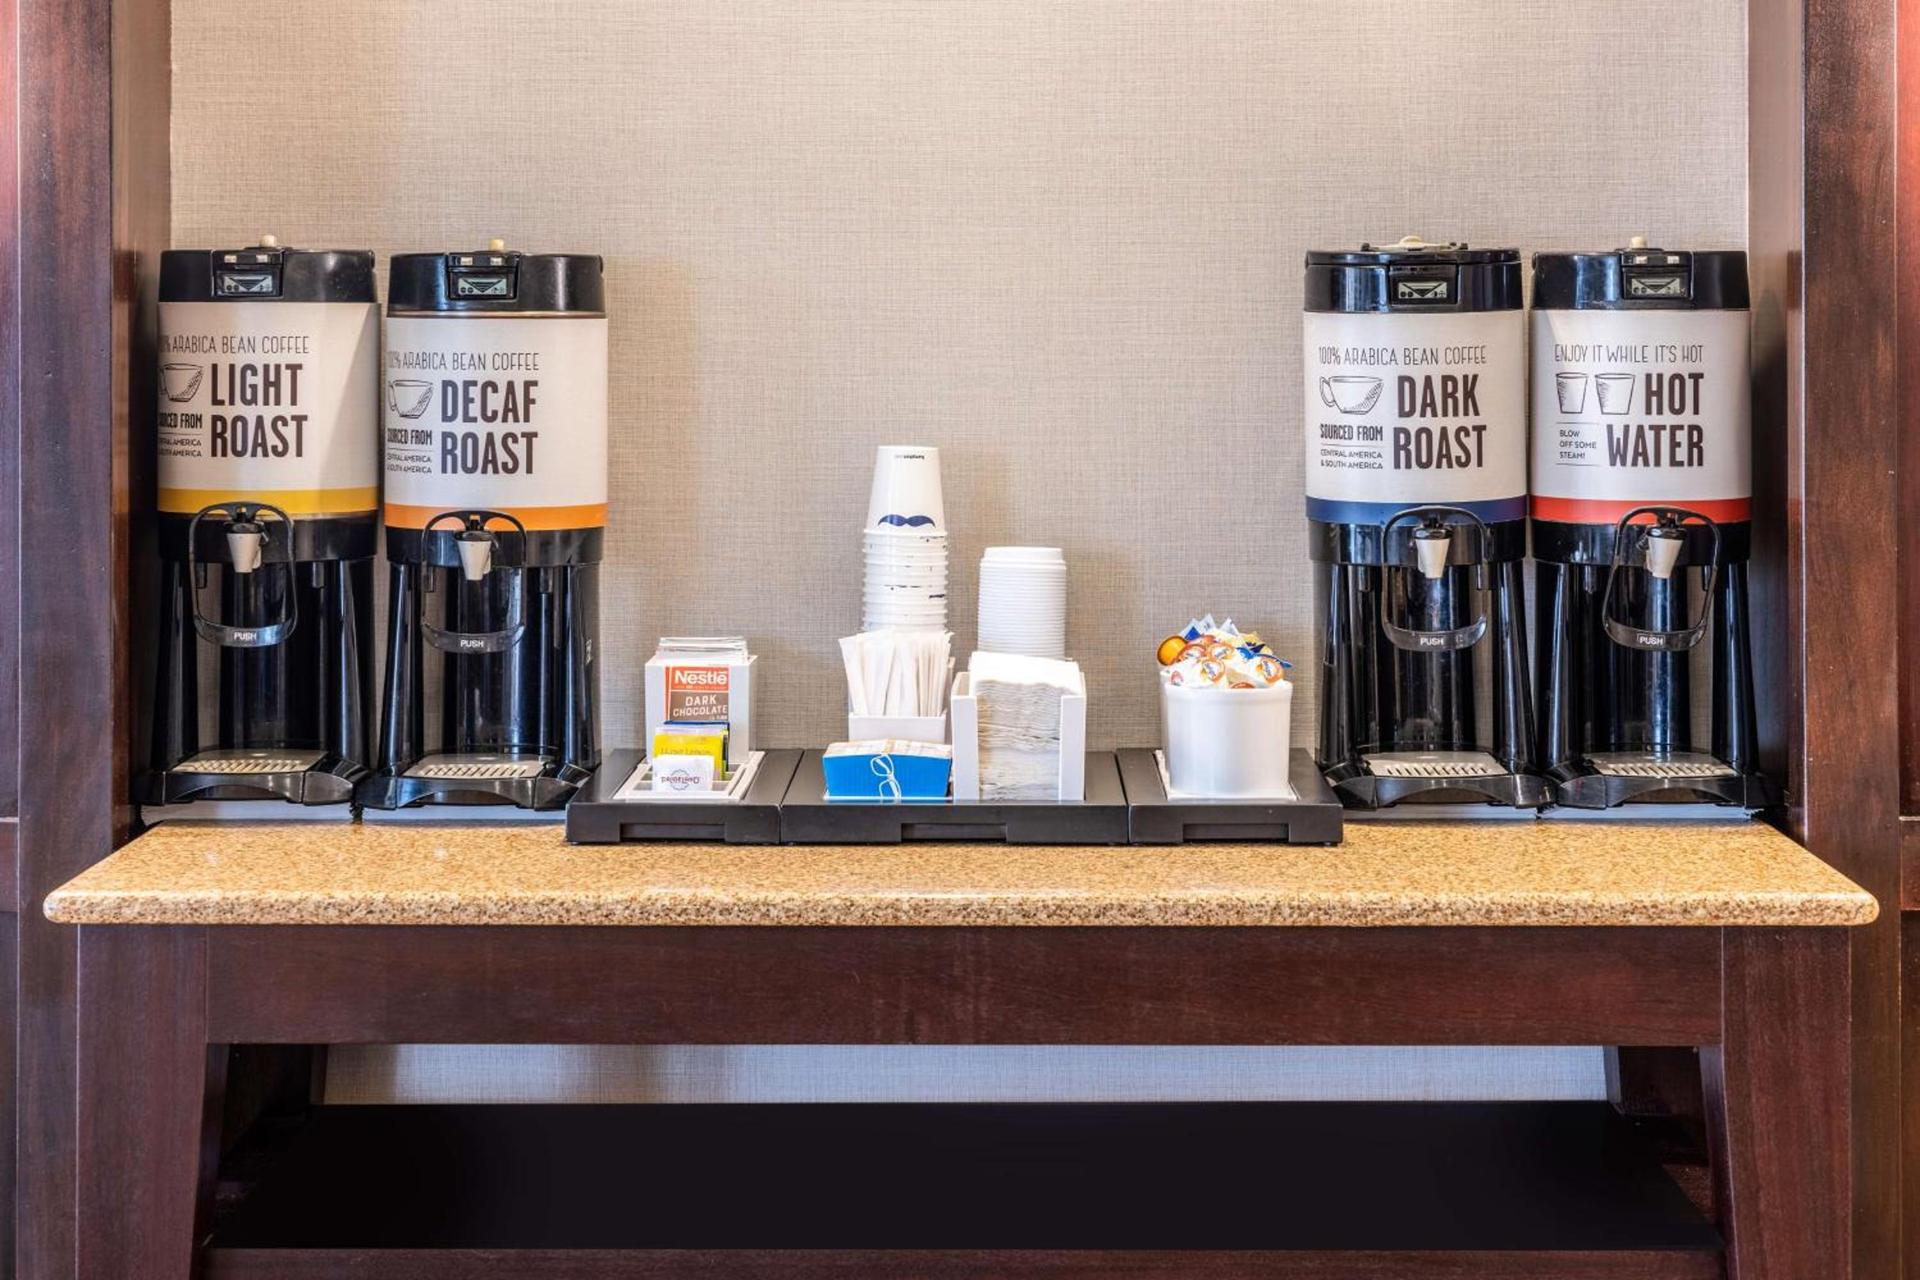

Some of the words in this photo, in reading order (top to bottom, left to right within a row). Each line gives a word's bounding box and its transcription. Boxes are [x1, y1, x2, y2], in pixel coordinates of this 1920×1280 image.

[172, 336, 217, 353] ARABICA
[222, 336, 256, 354] BEAN
[262, 336, 310, 354] COFFEE
[1554, 344, 1588, 363] ENJOY
[1593, 344, 1603, 363] IT
[1606, 345, 1649, 363] WHILE
[1655, 345, 1677, 363] IT'S
[1682, 344, 1704, 363] HOT
[402, 352, 447, 371] ARABICA
[453, 352, 486, 371] BEAN
[494, 352, 540, 371] COFFEE
[1318, 346, 1341, 366] 100%
[1344, 347, 1399, 366] ARABICA
[1404, 347, 1439, 366] BEAN
[1444, 345, 1487, 364] COFFEE
[211, 363, 303, 407] LIGHT
[1644, 372, 1704, 416] HOT
[441, 379, 539, 423] DECAF
[1397, 374, 1480, 418] DARK
[180, 413, 203, 429] FROM
[211, 414, 308, 458] ROAST
[411, 429, 433, 446] FROM
[1320, 423, 1354, 440] SOURCED
[1357, 425, 1383, 441] FROM
[1559, 429, 1580, 437] BLOW
[441, 431, 538, 475] ROAST
[1320, 448, 1347, 458] CENTRAL
[1348, 451, 1383, 459] AMERICA
[1393, 424, 1487, 470] ROAST
[1559, 440, 1573, 448] OFF
[1574, 441, 1597, 449] SOME
[1606, 424, 1704, 468] WATER
[1347, 461, 1383, 470] AMERICA
[233, 631, 257, 641] PUSH
[460, 639, 484, 648] PUSH
[1420, 637, 1444, 646] PUSH
[1639, 635, 1664, 645] PUSH
[685, 694, 717, 707] DARK
[672, 704, 728, 717] CHOCOLATE
